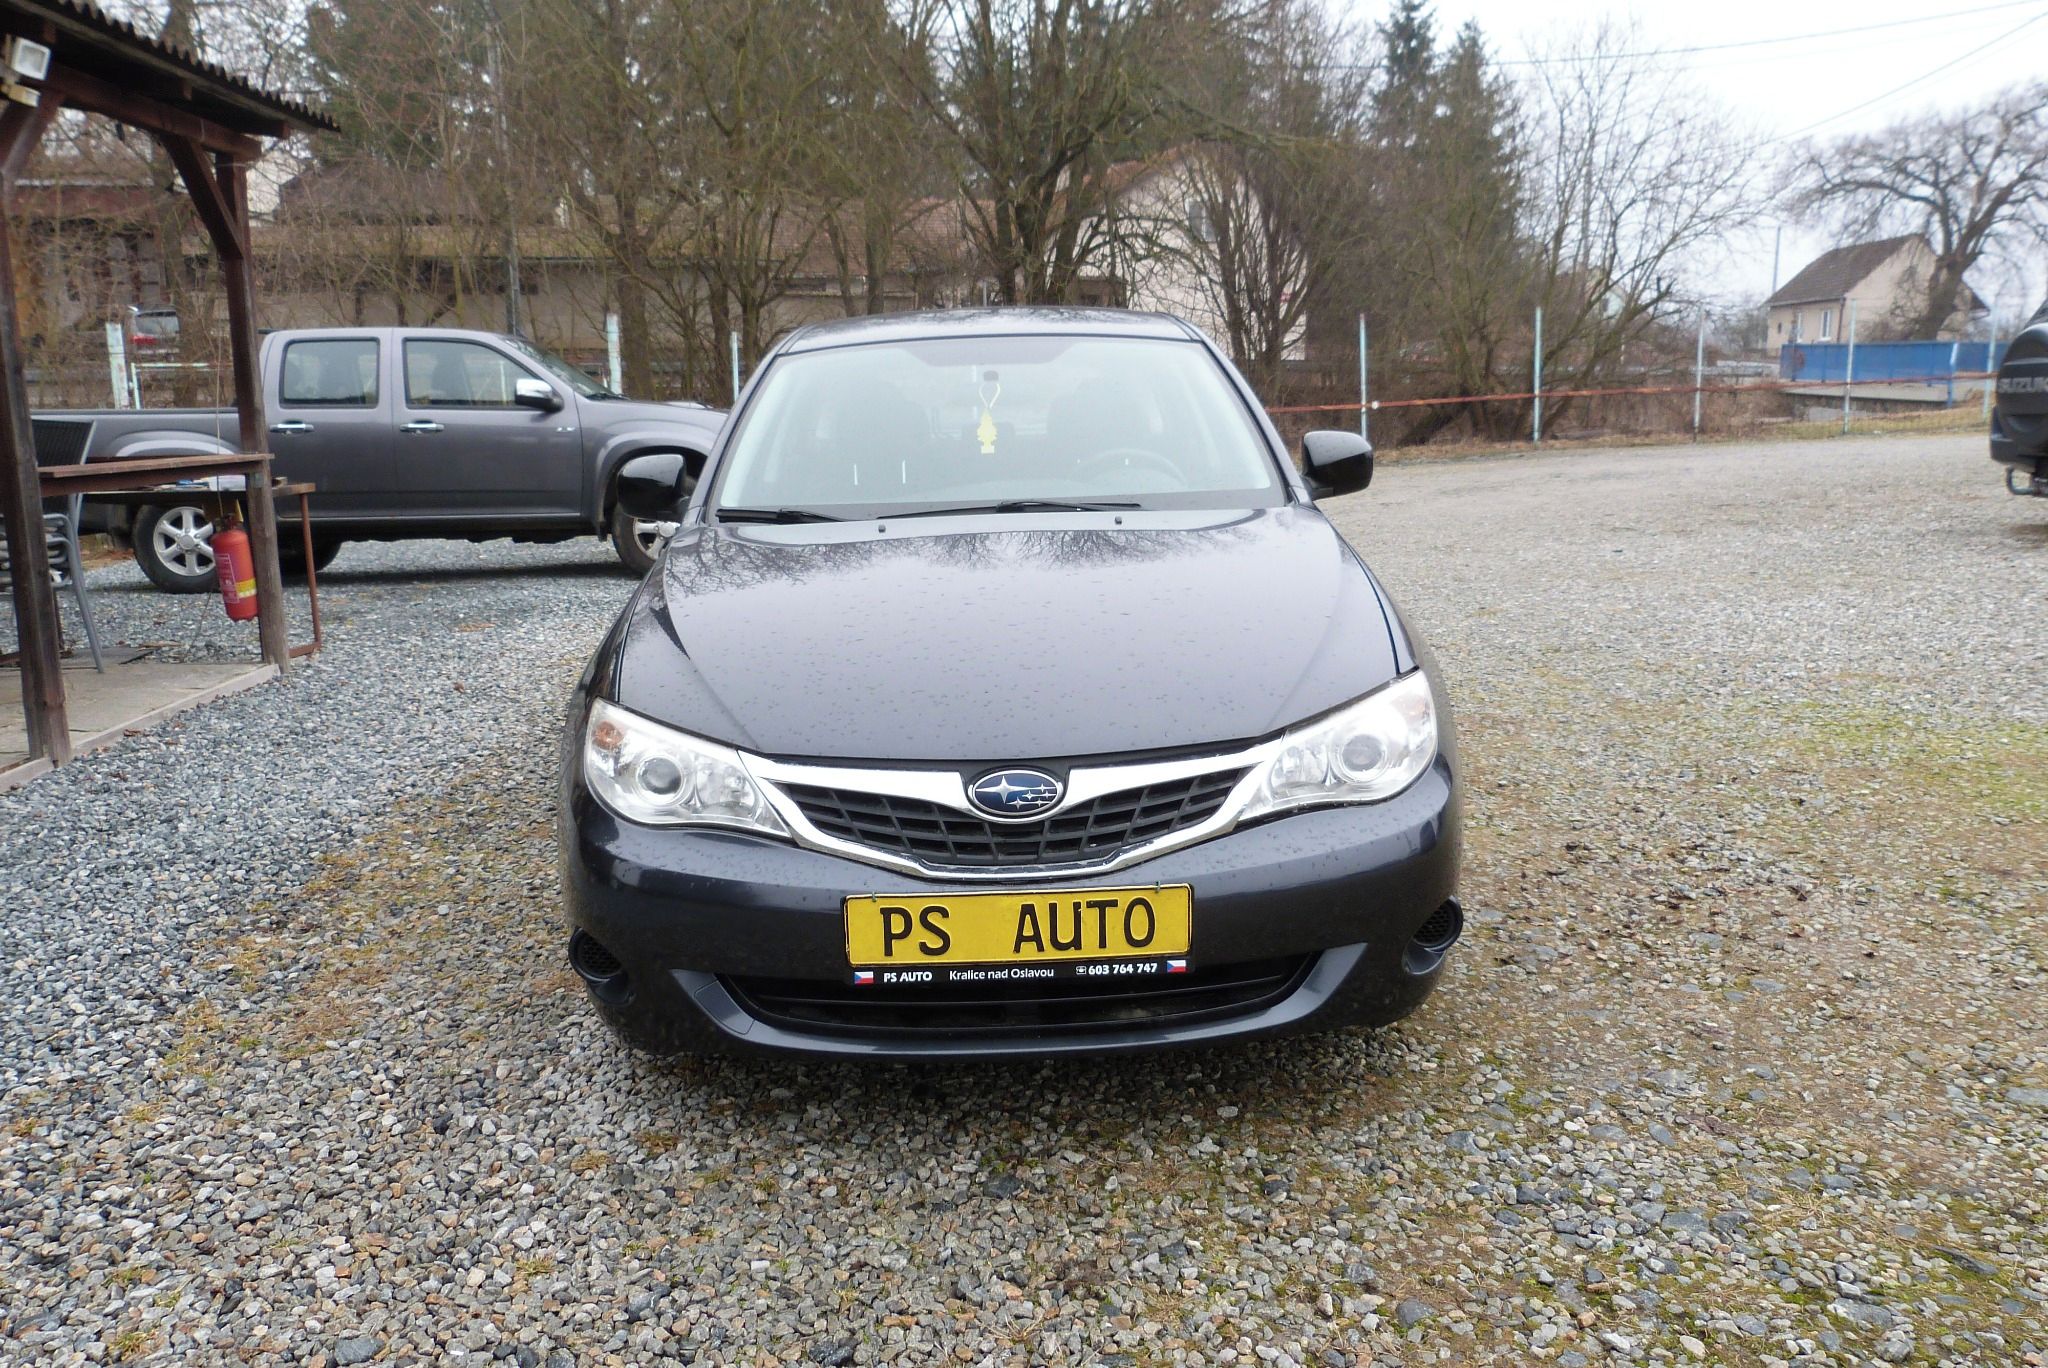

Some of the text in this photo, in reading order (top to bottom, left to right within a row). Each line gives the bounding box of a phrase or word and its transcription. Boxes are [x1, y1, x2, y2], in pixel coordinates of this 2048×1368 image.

[879, 897, 1156, 957] PS AUTO
[949, 967, 1054, 981] Kralice nad Oslavou
[1088, 963, 1158, 975] 603 764 747
[883, 971, 932, 983] PS AUTO
